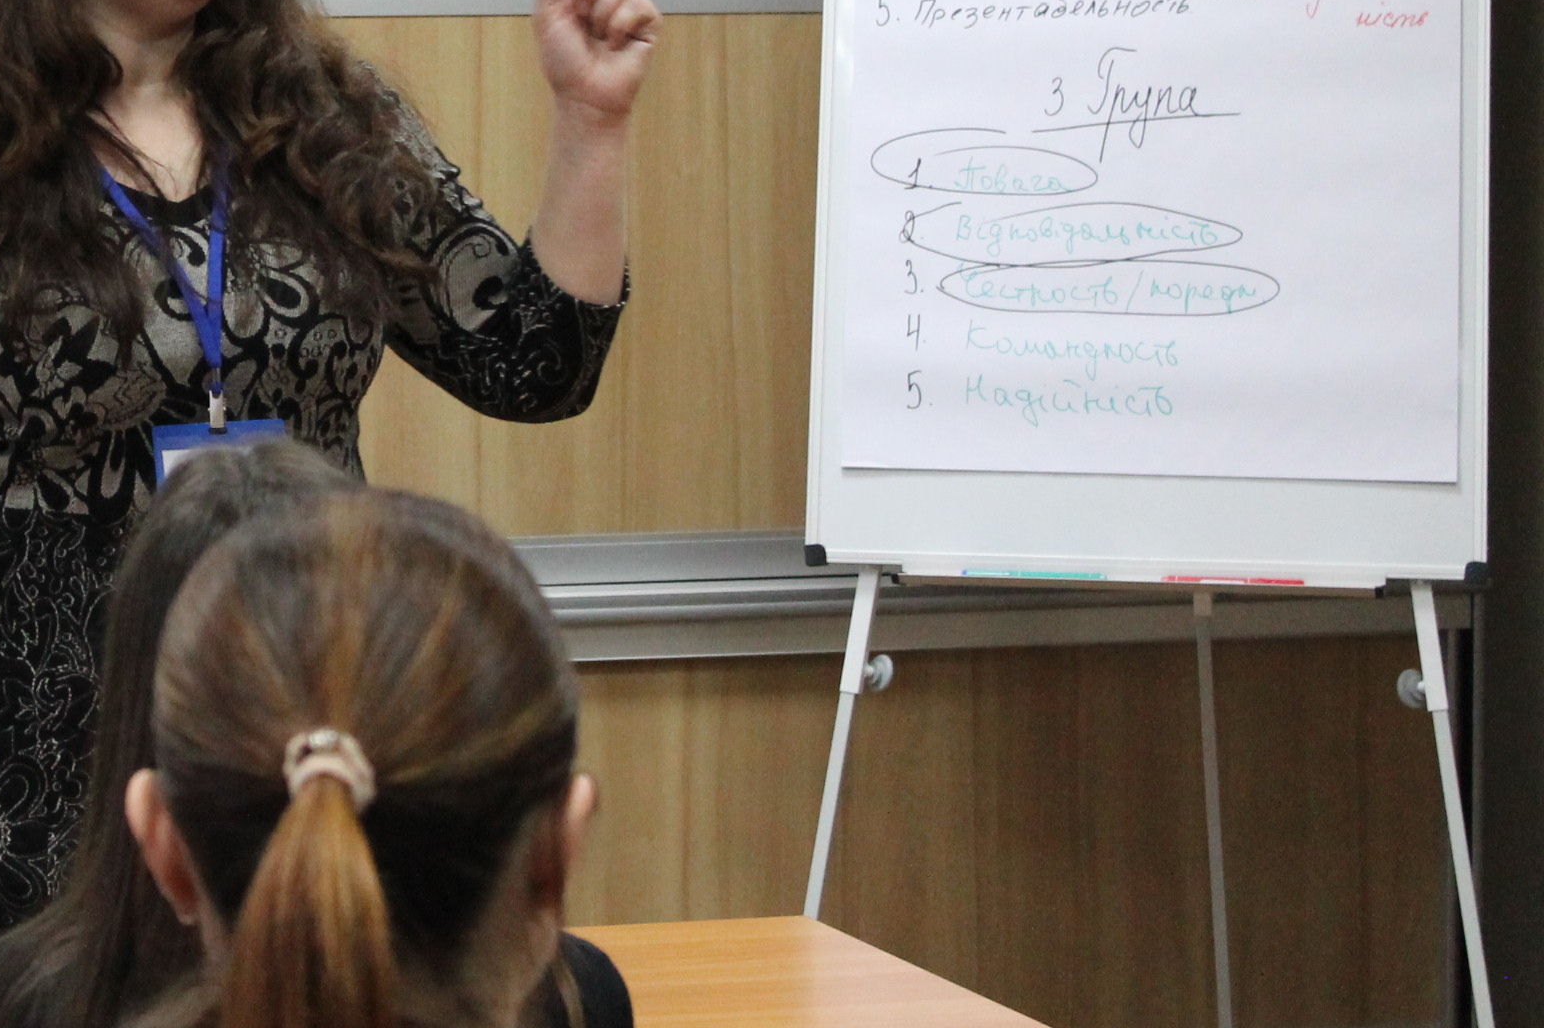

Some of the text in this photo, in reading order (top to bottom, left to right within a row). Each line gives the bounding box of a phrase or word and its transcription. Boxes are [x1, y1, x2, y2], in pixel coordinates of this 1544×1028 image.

[1043, 46, 1202, 163] 3 Група
[953, 156, 1076, 193] Повага
[903, 259, 926, 294] 3.
[906, 314, 1179, 381] 4. Командность
[906, 370, 1174, 427] 5. Надійність
